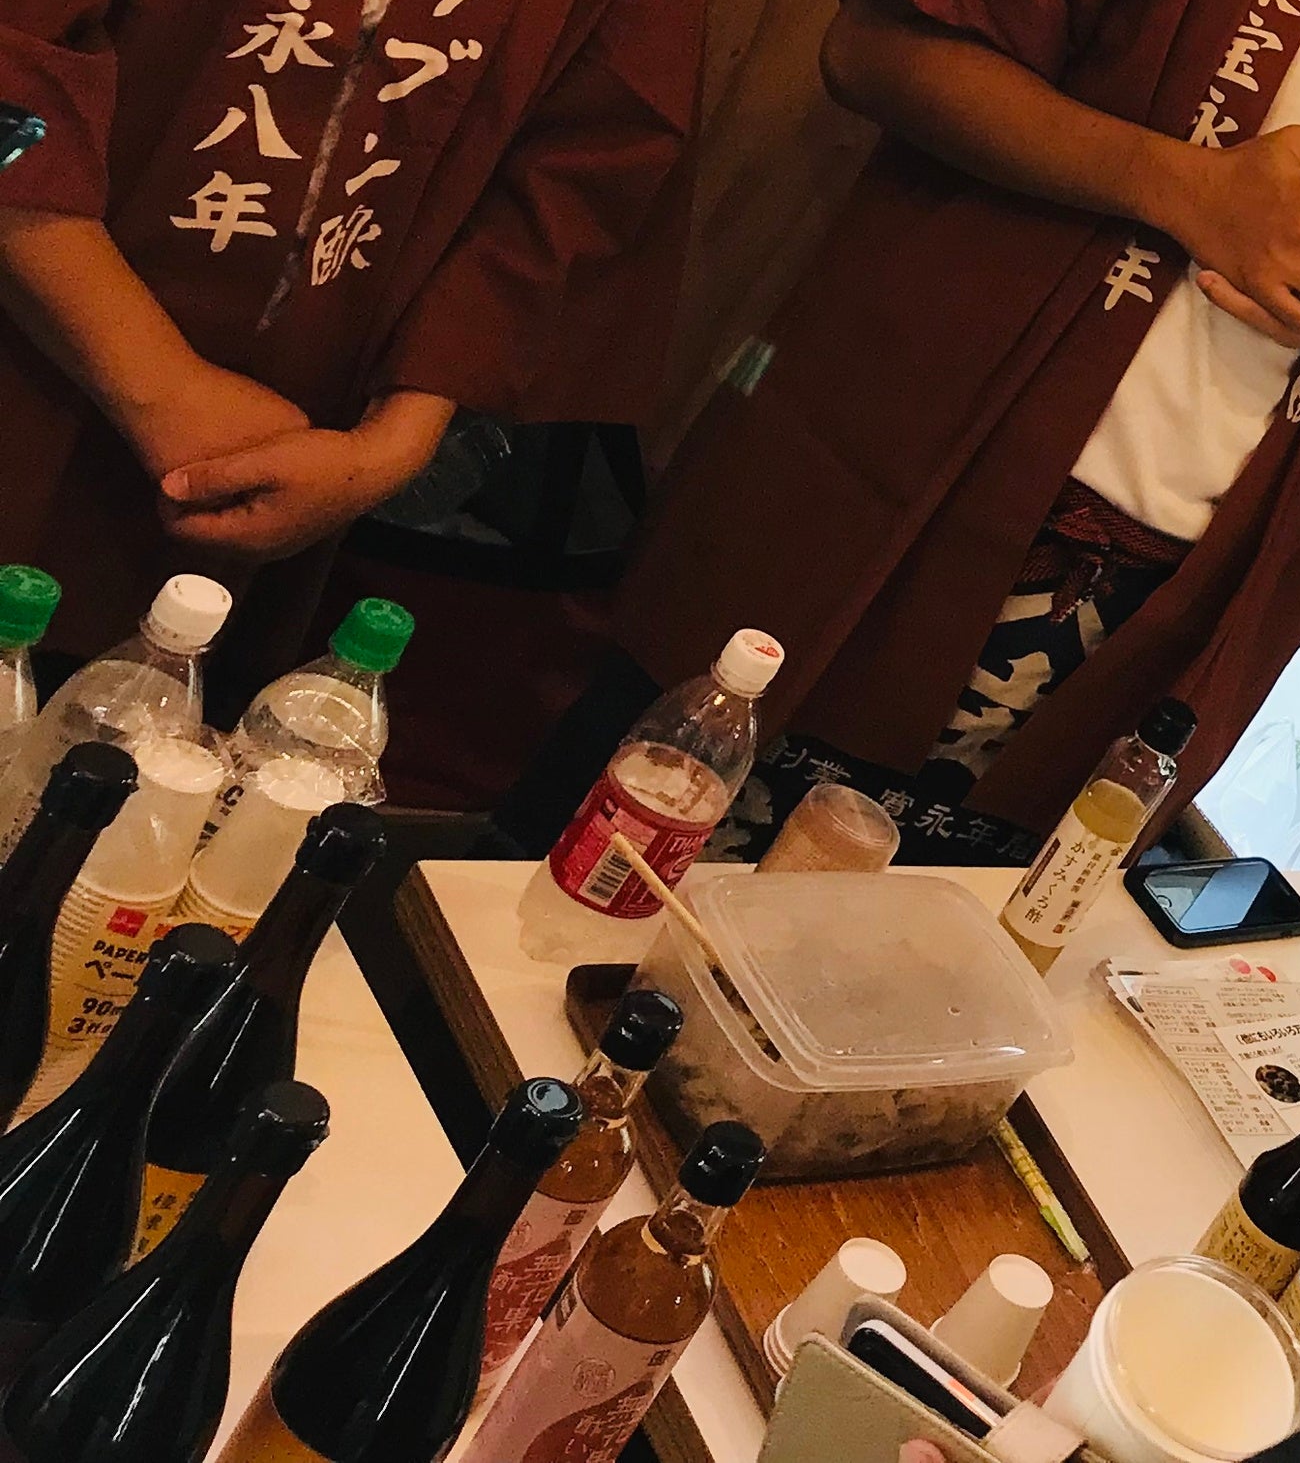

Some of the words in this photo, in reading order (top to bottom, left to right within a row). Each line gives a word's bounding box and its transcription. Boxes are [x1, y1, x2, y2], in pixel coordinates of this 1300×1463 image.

[1024, 839, 1088, 926] かすみくろ酢
